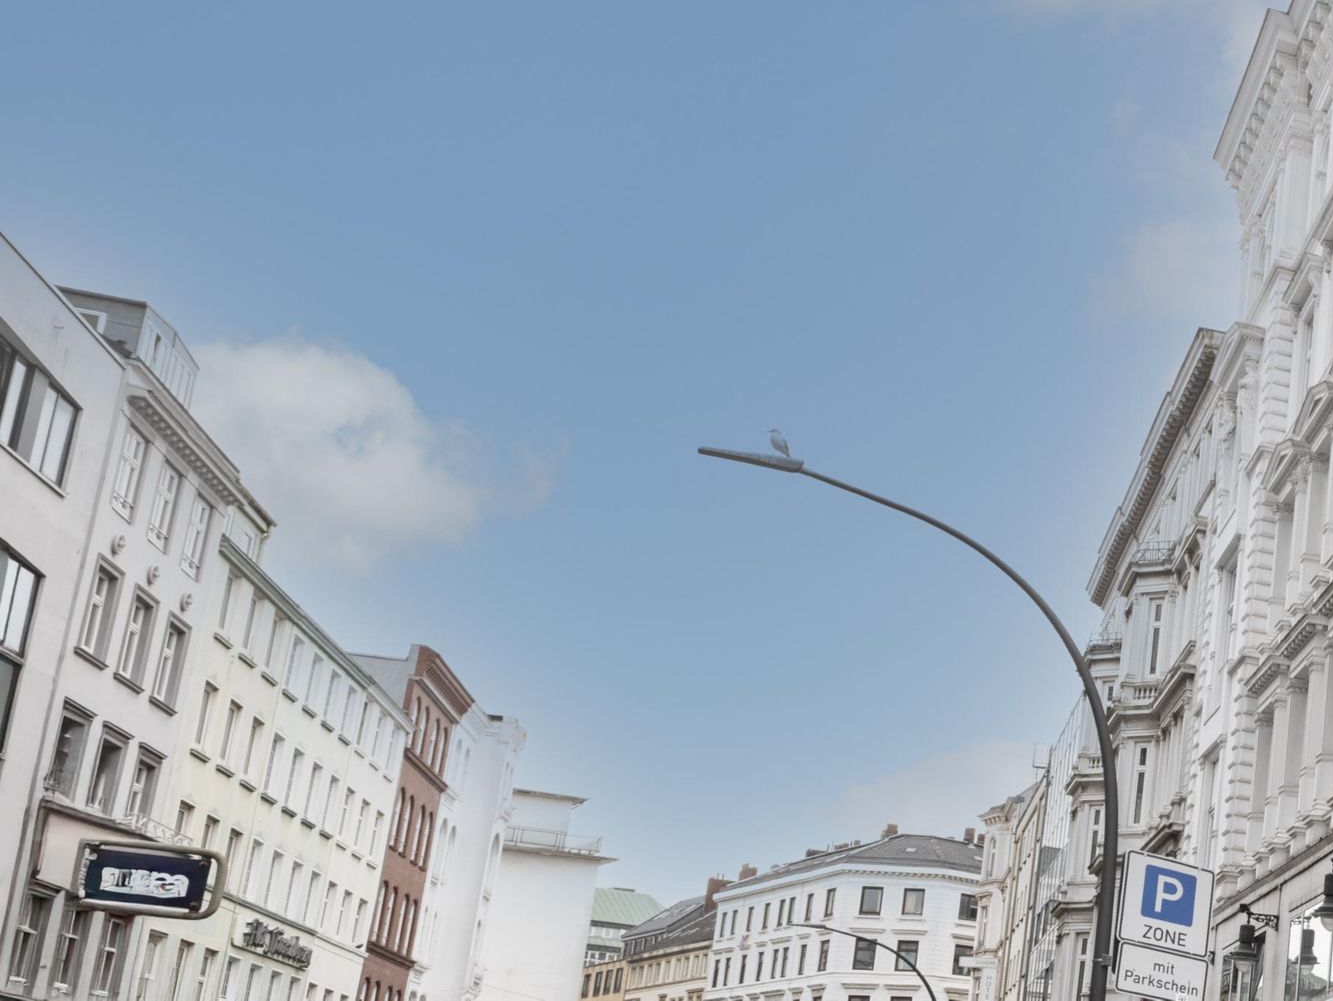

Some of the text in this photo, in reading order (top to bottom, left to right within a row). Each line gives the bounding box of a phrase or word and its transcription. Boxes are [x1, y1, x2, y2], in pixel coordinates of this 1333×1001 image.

[1154, 874, 1184, 913] P
[1142, 924, 1187, 947] ZONE
[1153, 961, 1176, 976] mit
[1124, 969, 1199, 996] Parkschein
